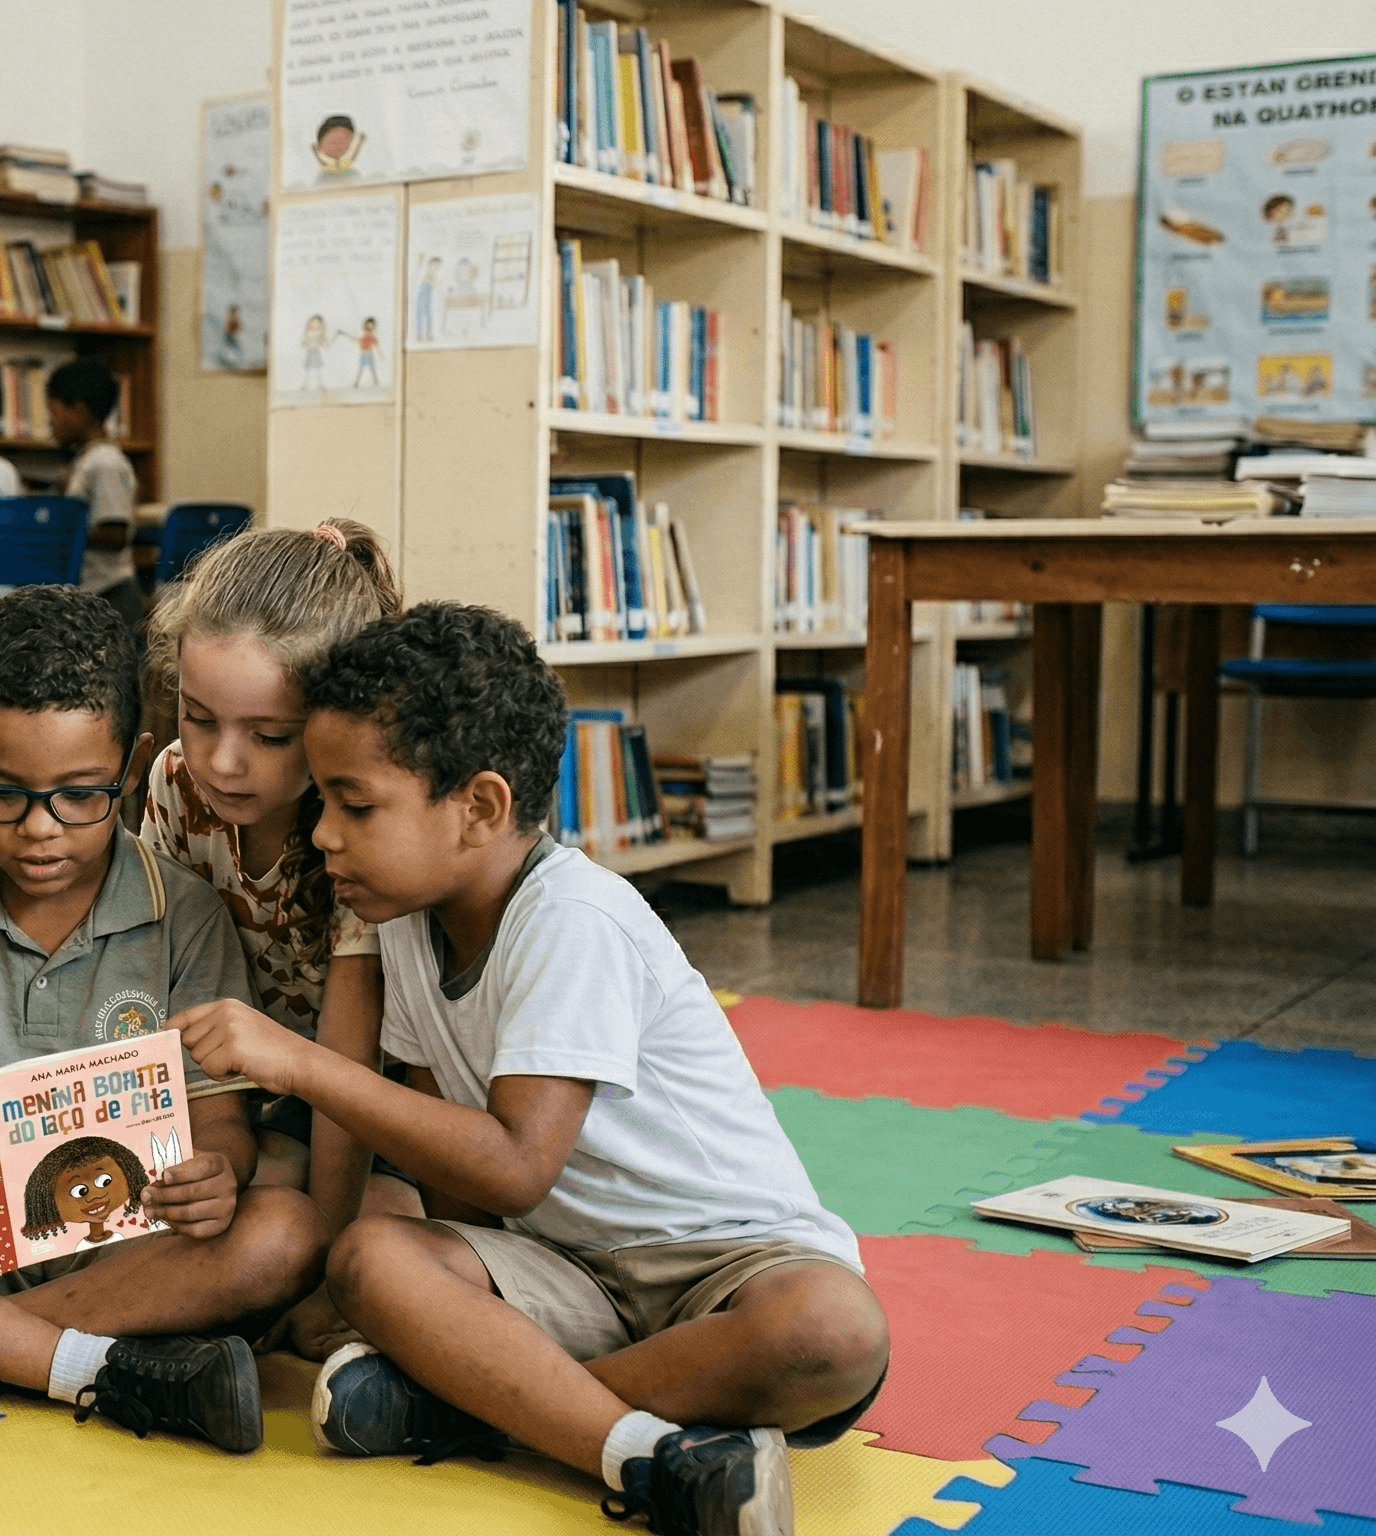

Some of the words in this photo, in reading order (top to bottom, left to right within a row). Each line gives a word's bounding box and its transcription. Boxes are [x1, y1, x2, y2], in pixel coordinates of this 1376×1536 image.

[1177, 86, 1195, 104] O
[30, 1071, 53, 1083] ANA
[55, 1062, 86, 1077] MARIA
[88, 1049, 139, 1069] MACHADO
[95, 1099, 122, 1124] de
